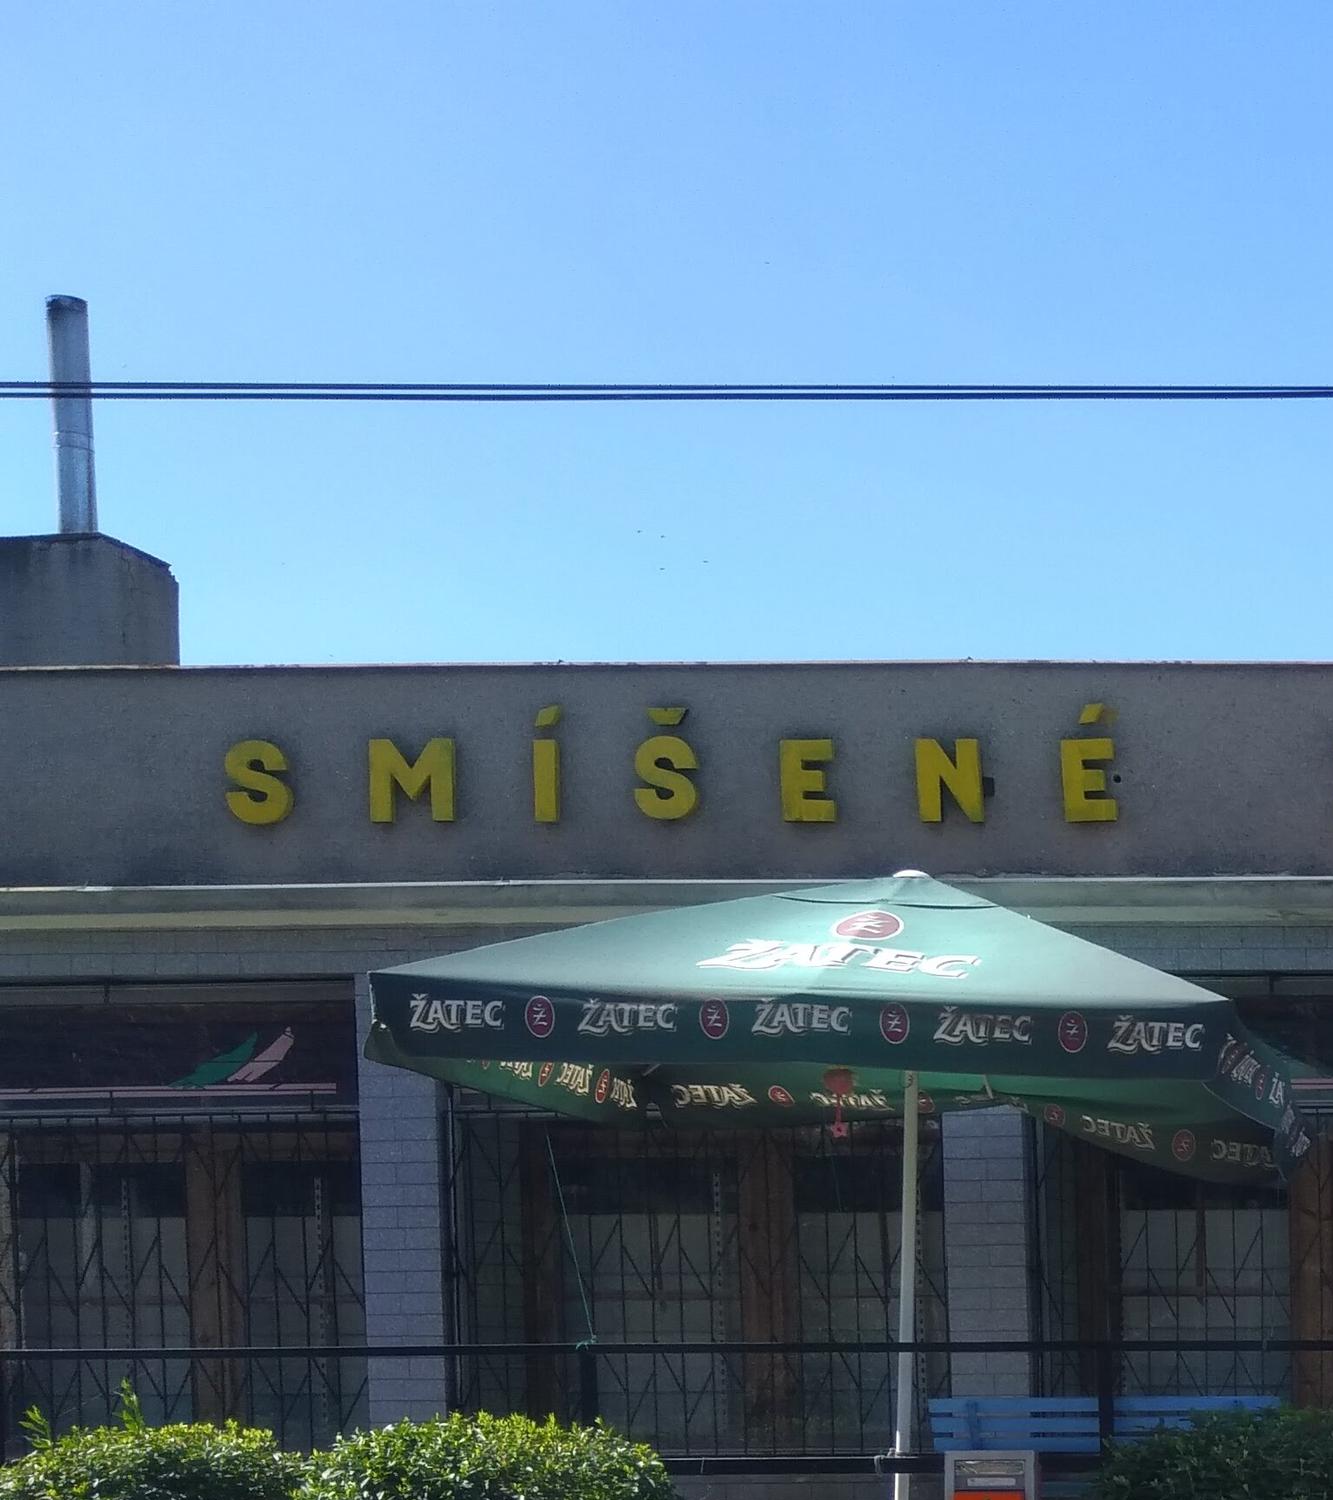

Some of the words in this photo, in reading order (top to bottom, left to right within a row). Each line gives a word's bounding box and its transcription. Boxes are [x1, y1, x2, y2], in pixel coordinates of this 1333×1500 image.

[223, 703, 1118, 826] SMÍŠENÉ
[695, 937, 983, 979] ŽATEC
[408, 992, 506, 1033] ŽATEC
[576, 997, 678, 1037] ŽATEC
[750, 997, 851, 1037] ŽATEC
[932, 1004, 1034, 1046] ŽATEC
[1106, 1013, 1205, 1055] ŽATEC
